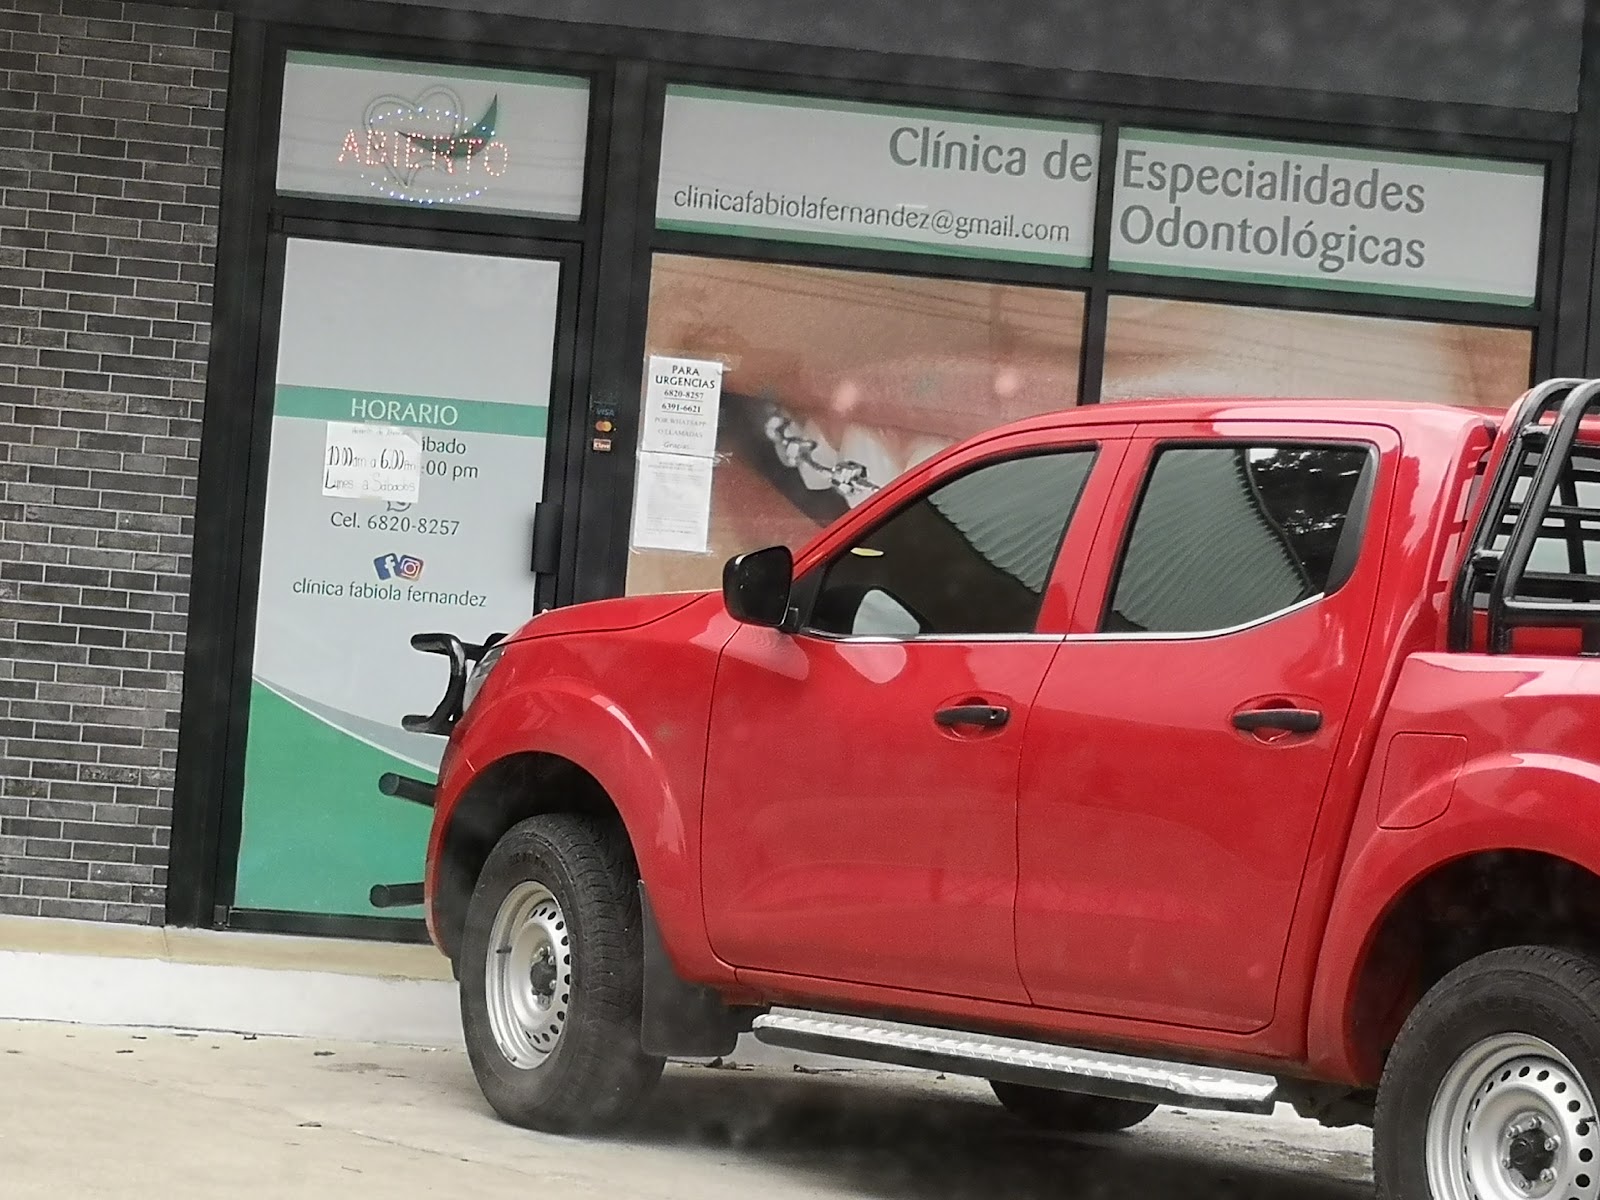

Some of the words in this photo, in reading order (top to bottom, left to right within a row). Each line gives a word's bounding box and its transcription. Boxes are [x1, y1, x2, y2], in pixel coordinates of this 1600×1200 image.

[337, 128, 508, 177] ABIERTO
[888, 126, 1027, 177] Clínica
[1042, 139, 1093, 182] de
[1122, 149, 1425, 214] Especialidades
[673, 185, 1070, 243] clinicafabiolafernandez@gmail.com
[1119, 204, 1425, 273] Odontológicas
[655, 375, 716, 390] URGENCIAS
[671, 365, 700, 376] PARA
[661, 402, 701, 413] 6391-6621
[663, 389, 704, 399] 6820-8257
[350, 397, 459, 426] HORARIO
[452, 464, 479, 481] pm
[330, 511, 361, 529] Cel.
[367, 514, 460, 536] 6820-8257
[292, 578, 344, 597] clínica
[349, 581, 401, 601] fabiola
[407, 585, 487, 607] fernandez
